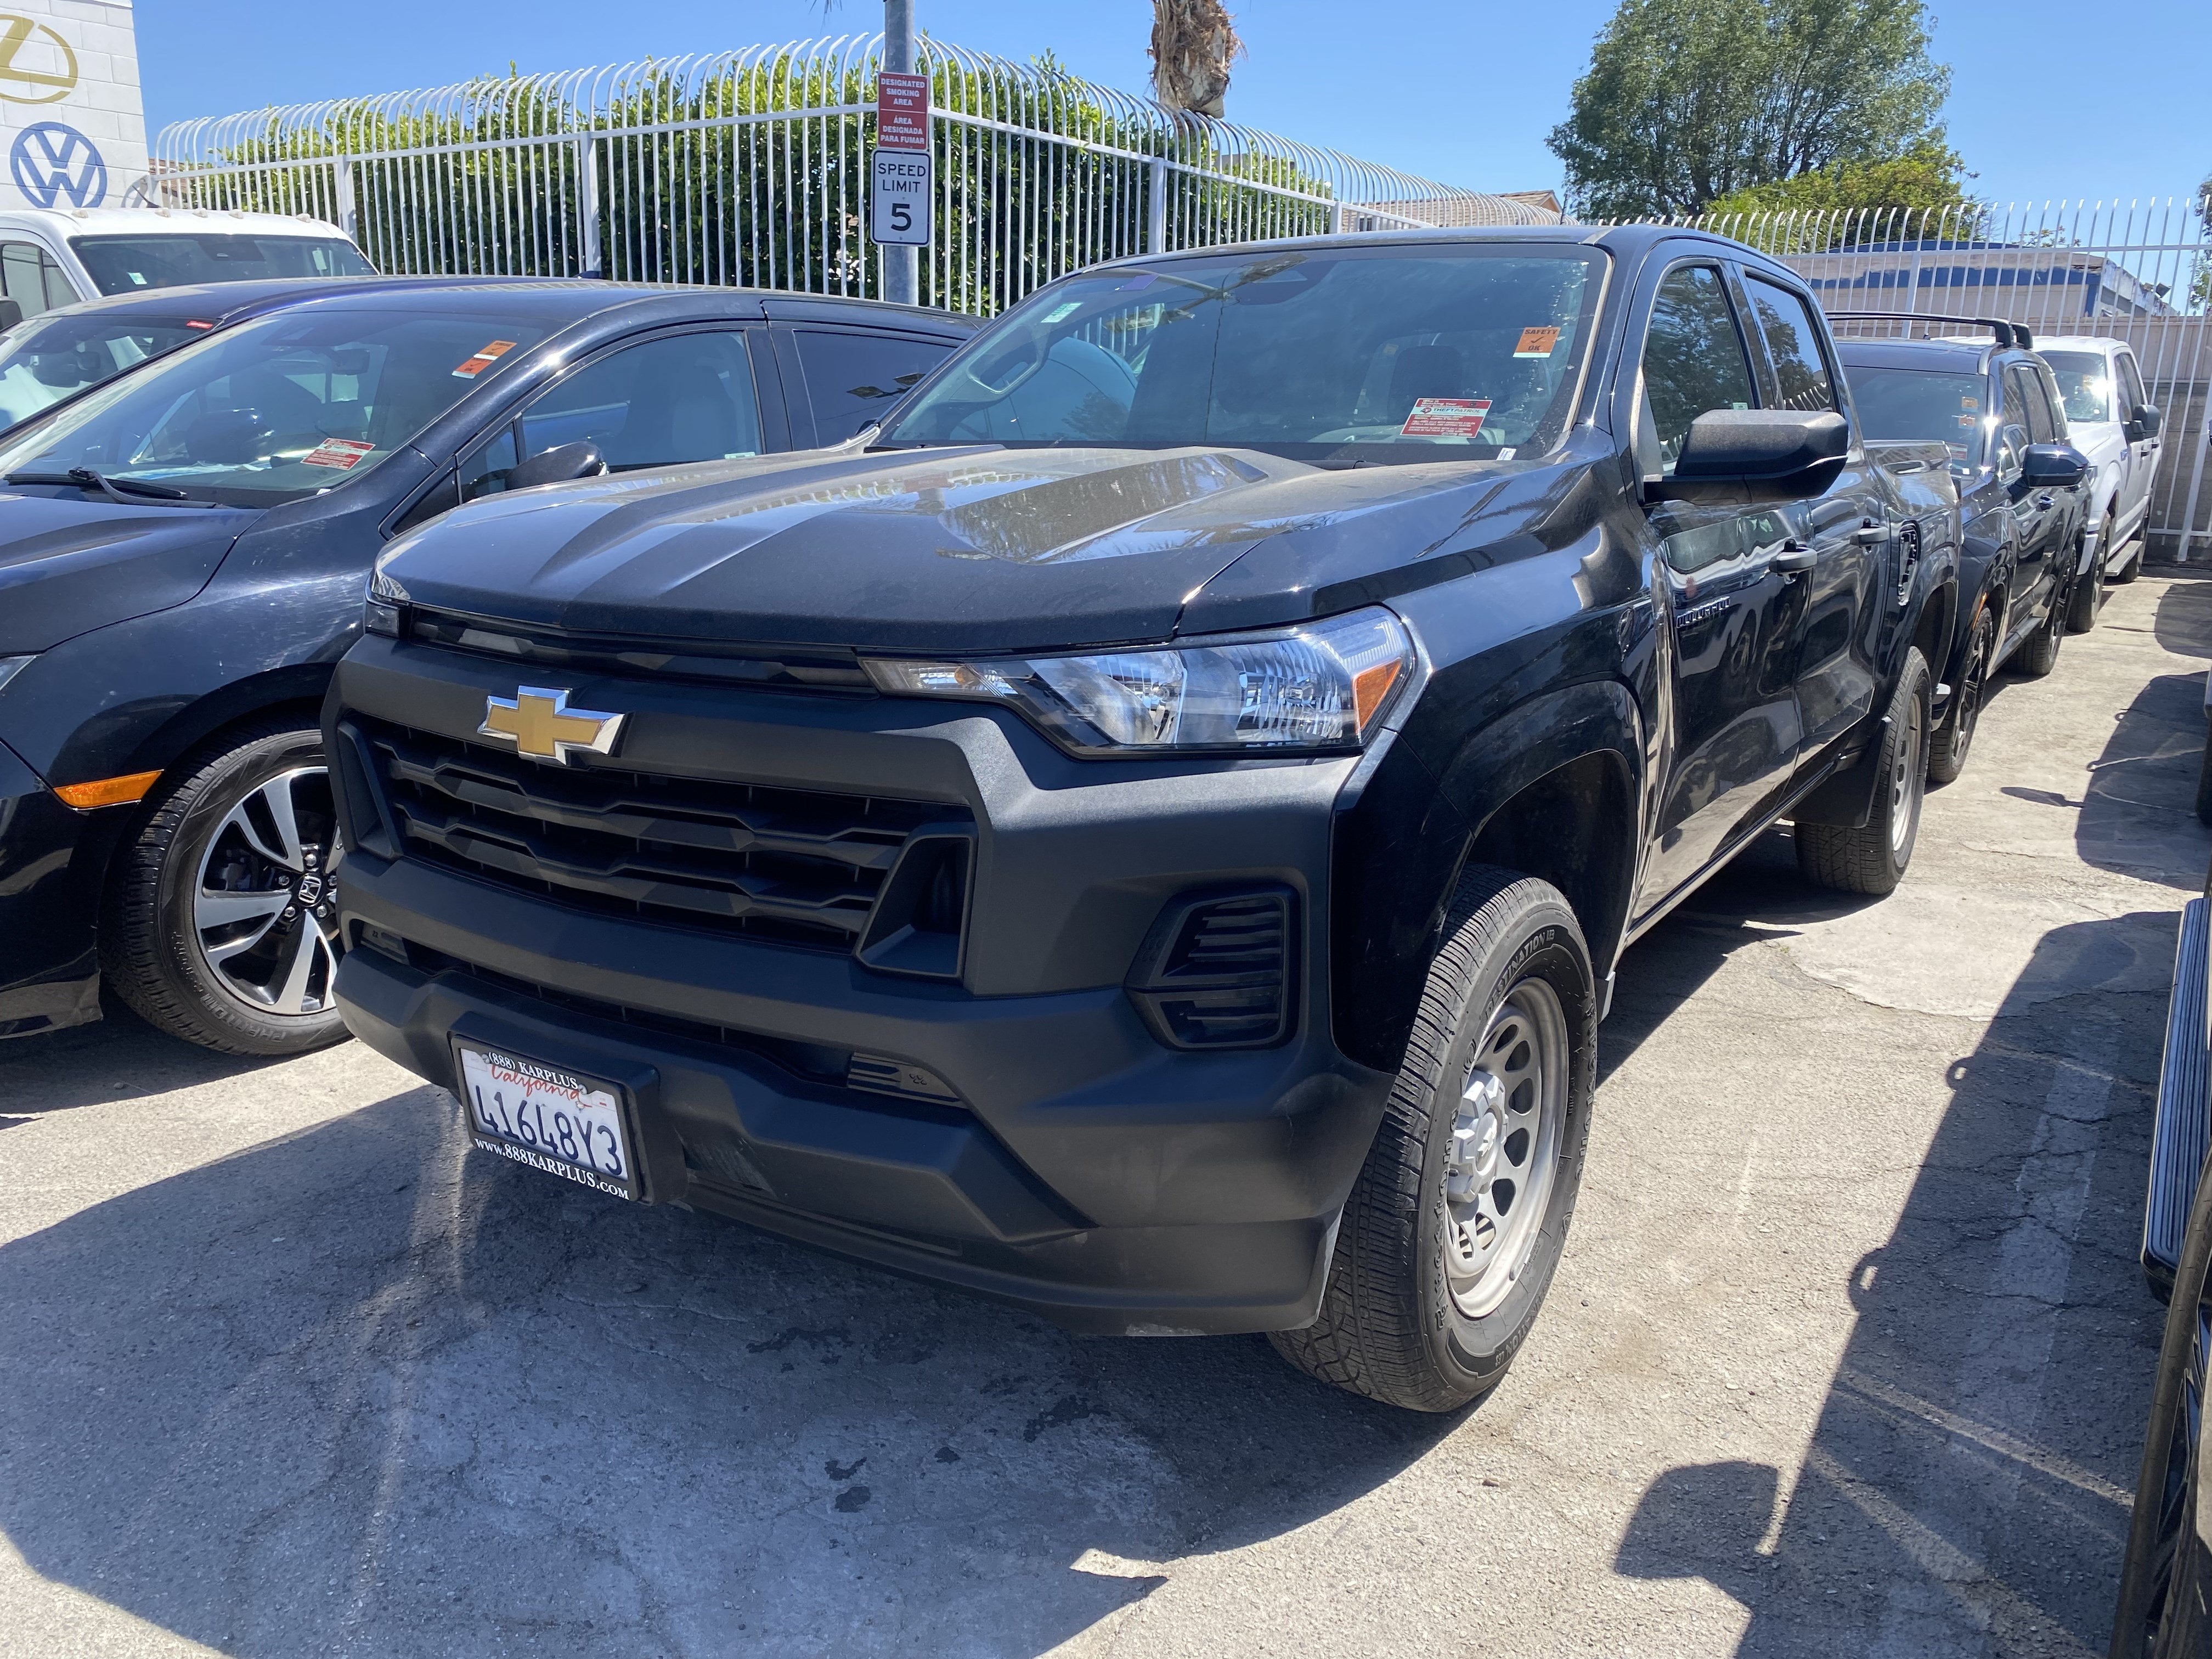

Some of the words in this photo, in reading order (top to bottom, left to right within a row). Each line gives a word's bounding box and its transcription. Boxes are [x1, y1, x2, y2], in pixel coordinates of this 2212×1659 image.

[881, 78, 926, 88] DESIGNATED
[886, 88, 920, 97] SMOKING
[893, 98, 913, 106] AREA
[894, 115, 912, 125] ÁREA
[882, 126, 923, 135] DESIGNADA
[881, 135, 899, 143] PARA
[900, 136, 925, 145] FUMAR
[878, 163, 926, 177] SPEED
[882, 179, 921, 193] LIMIT
[890, 203, 912, 232] 5
[1484, 931, 1546, 1020] DESTINATION
[488, 1051, 516, 1070] (888)
[518, 1060, 579, 1090] KARPLUS
[491, 1064, 583, 1102] California
[475, 1085, 623, 1176] 41648Y3
